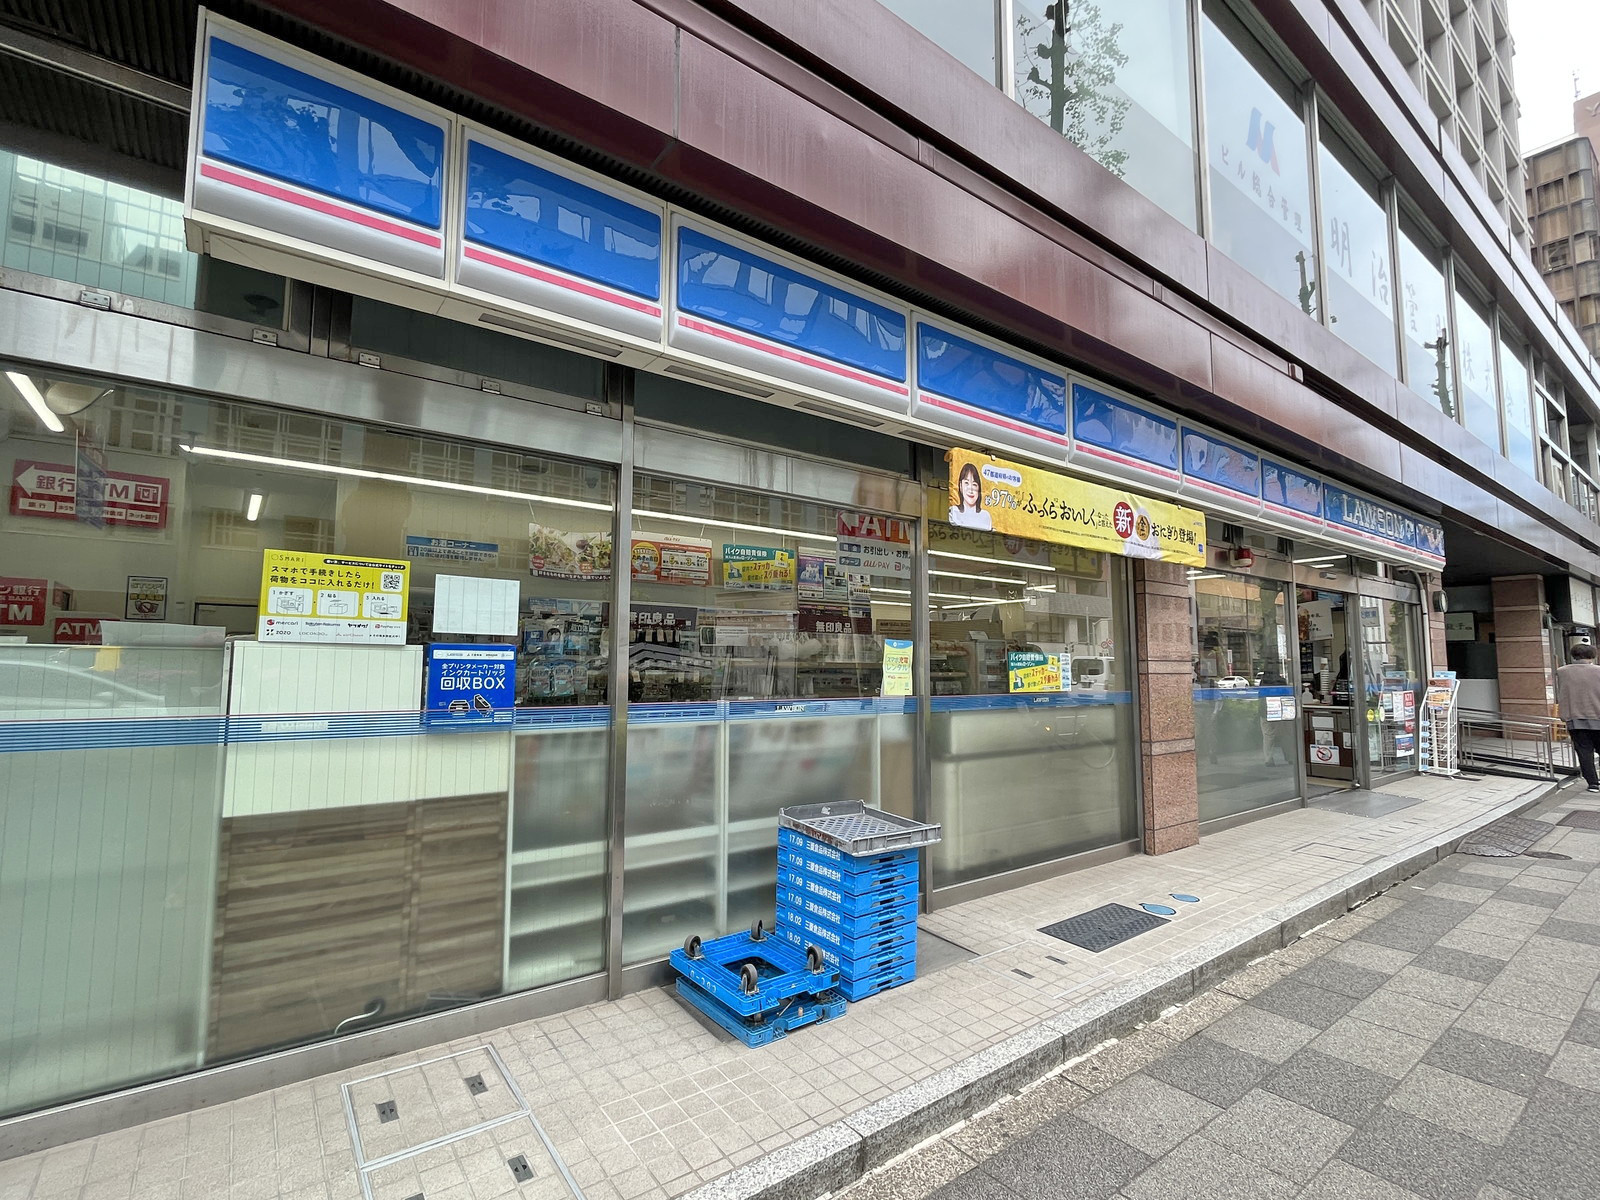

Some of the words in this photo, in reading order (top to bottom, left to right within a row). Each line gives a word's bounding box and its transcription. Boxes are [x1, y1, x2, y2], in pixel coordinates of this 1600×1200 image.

[1115, 506, 1132, 534] 新
[1342, 493, 1404, 539] LAWSON
[271, 565, 361, 579] スマホで手続きしたら
[815, 620, 852, 634] 無印良品
[440, 677, 506, 691] 回収BOX
[789, 834, 803, 847] 17.09
[789, 854, 803, 867] 17.09
[788, 873, 803, 887] 17.09
[788, 892, 802, 906] 17.09
[787, 912, 802, 926] 18.02
[786, 931, 801, 946] 18.02
